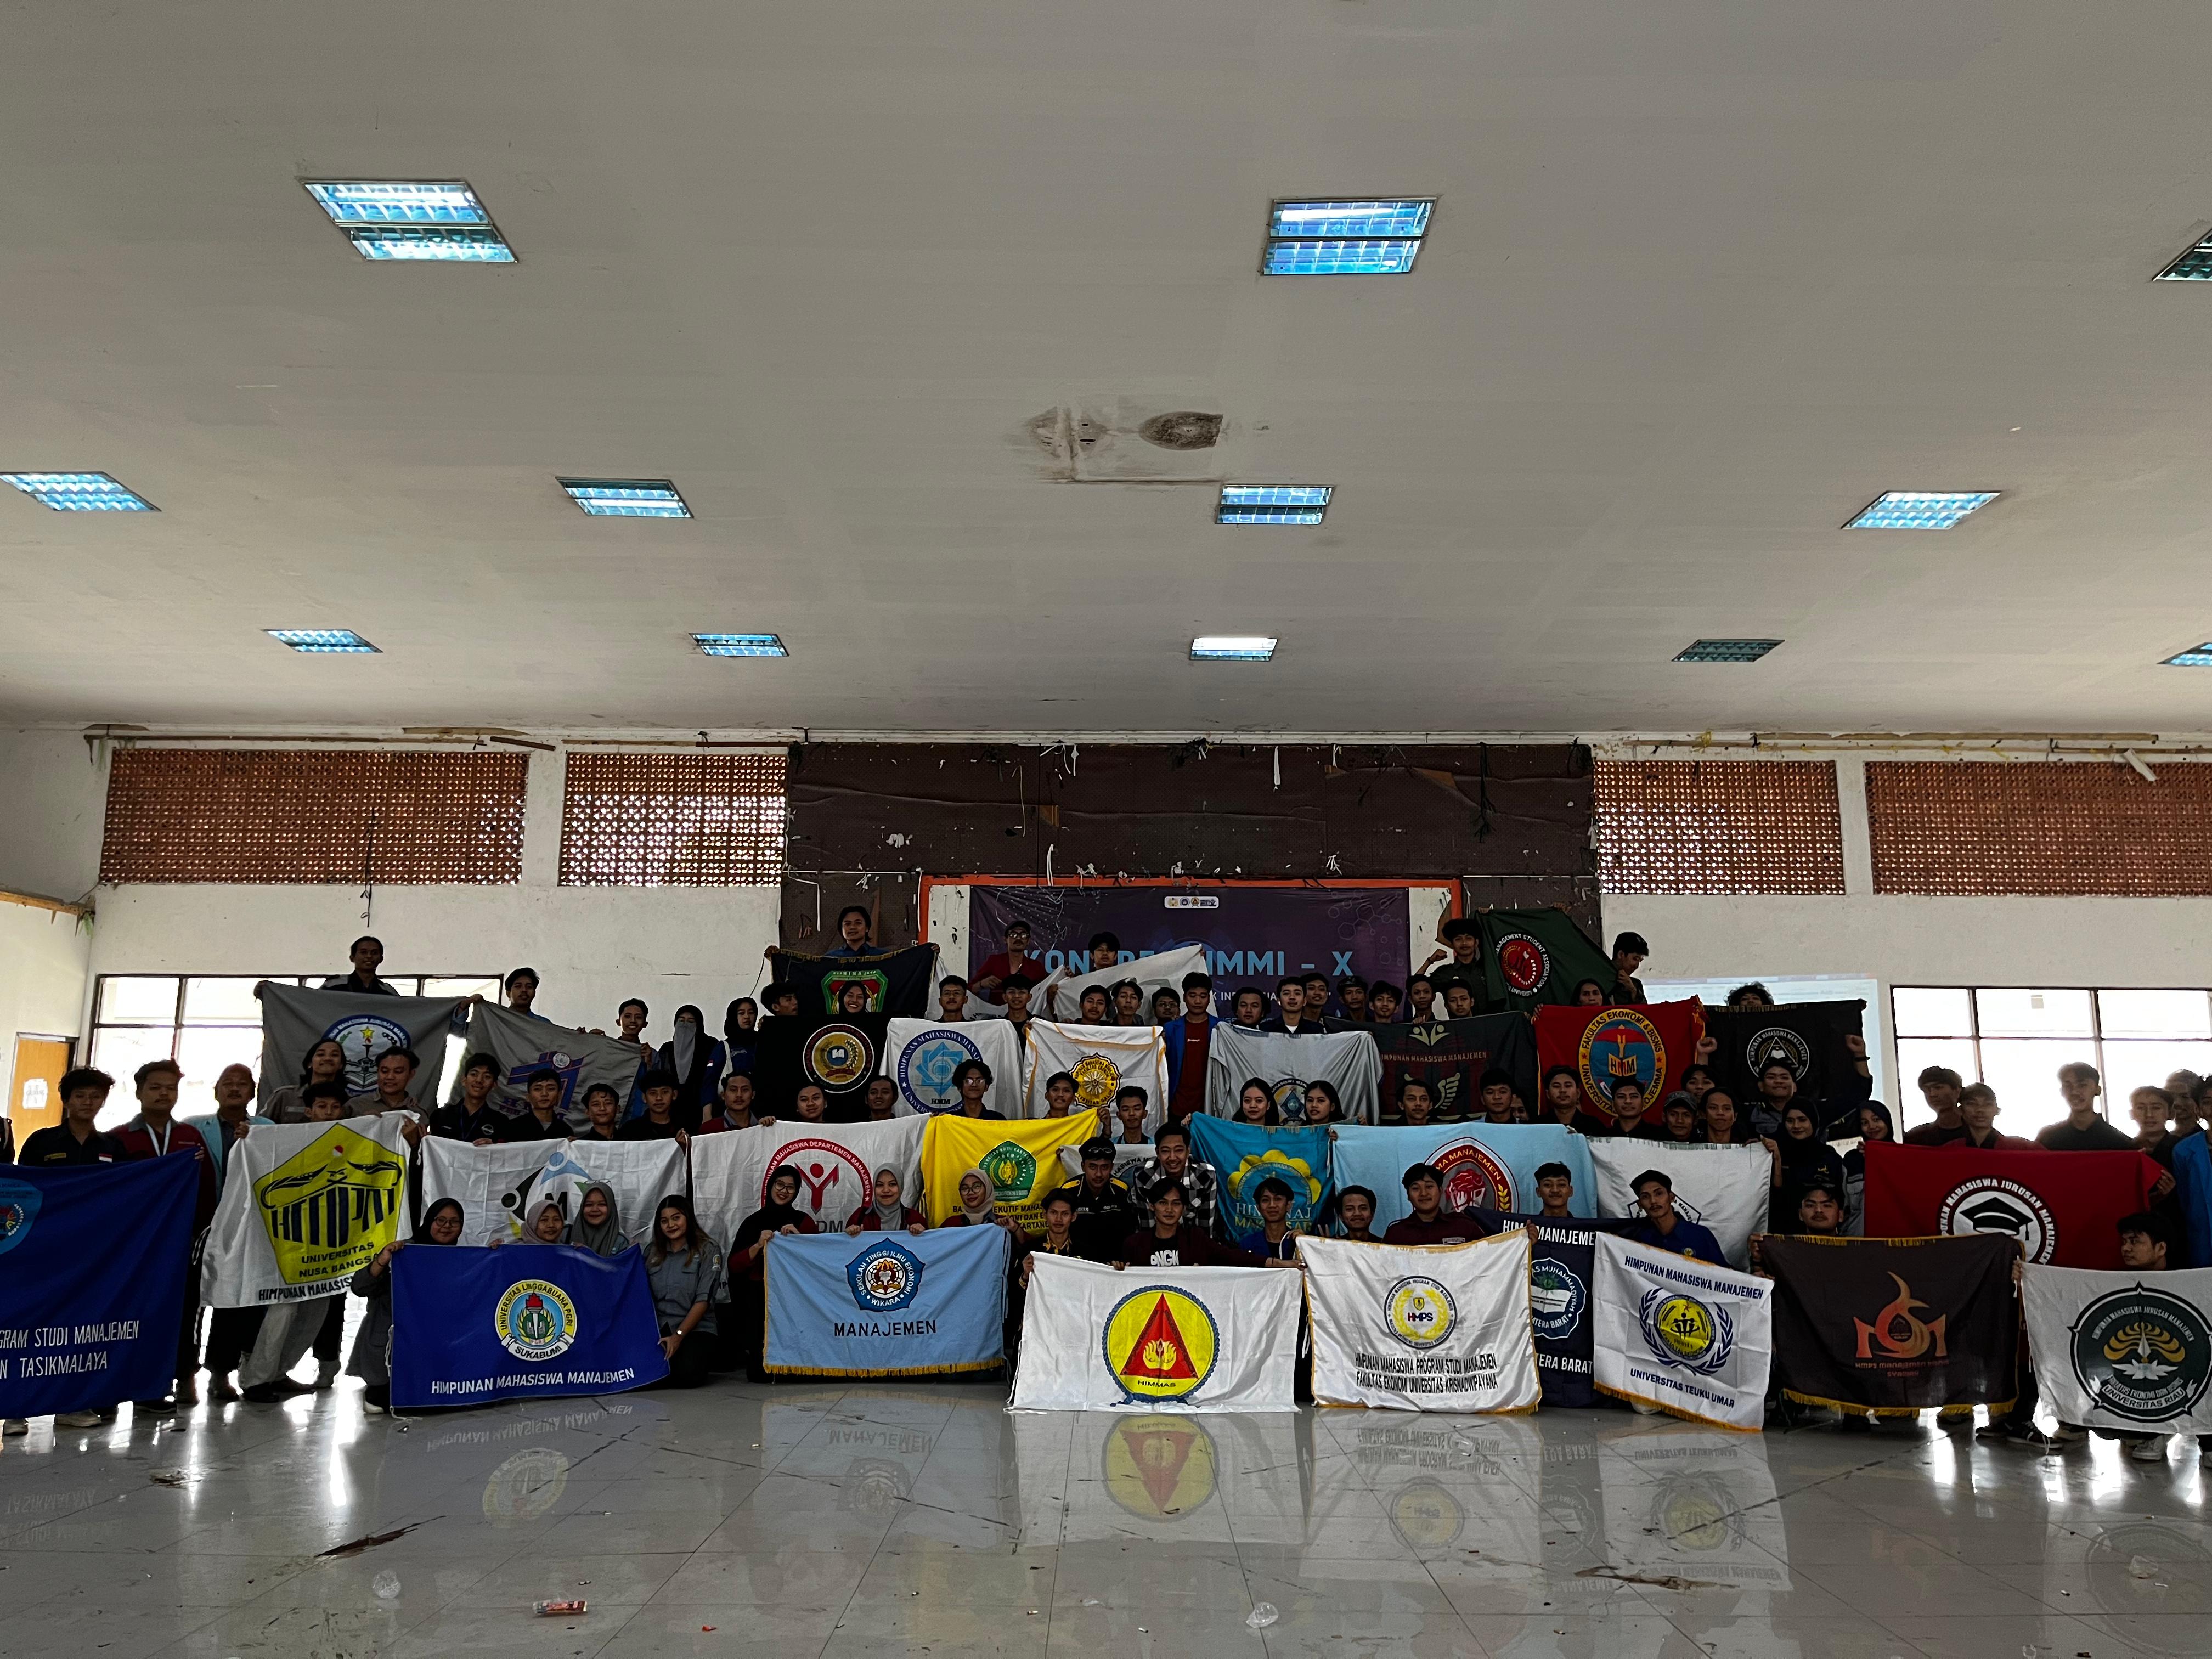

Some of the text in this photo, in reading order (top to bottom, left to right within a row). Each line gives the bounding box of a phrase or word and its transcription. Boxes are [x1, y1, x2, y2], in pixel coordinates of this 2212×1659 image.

[1332, 951, 1353, 975] X
[1582, 1016, 1607, 1049] FAKULTAS
[1607, 1011, 1645, 1025] EKONOMI
[1647, 1029, 1663, 1053] BISNIS
[900, 1042, 918, 1077] HIMPUNAN
[917, 1031, 961, 1042] MAHASISWA
[1381, 1052, 1487, 1063] IMPUNAN MAHASISWA MANAJEMEN
[1582, 1064, 1616, 1113] UNIVERSITA
[775, 1141, 808, 1160] MAHASISWA
[809, 1141, 851, 1160] DEPARTEMEN
[850, 1157, 871, 1194] MANAJEMEN
[1113, 1157, 1142, 1176] HASISWA
[1449, 1149, 1502, 1181] MANAJEMEN
[1945, 1178, 1999, 1206] MAHASISWA
[2001, 1180, 2043, 1209] JURUSAN
[992, 1205, 1019, 1214] EKUTIF
[1020, 1204, 1043, 1213] MAHAS
[1940, 1205, 1951, 1235] PUNAN
[817, 1220, 843, 1233] DM
[1022, 1221, 1049, 1229] ARTANE
[1503, 1219, 1595, 1246] HIM MANAJEME
[301, 1242, 375, 1263] UNIVERSITAS
[299, 1267, 328, 1278] NUSA
[856, 1250, 915, 1295] SEKOLAH TINGGI ILMU EKONOMI
[1624, 1256, 1764, 1300] HIMPUNAN MAHASISWA MANAJEMEN
[259, 1276, 354, 1301] HIMPUNAN MAHASIS
[1542, 1266, 1577, 1312] MUHAMMADIYAH
[500, 1283, 573, 1330] UNIVERSITAS LINGGABUANA PGRI
[871, 1296, 901, 1307] WIKARA
[834, 1319, 936, 1336] MANAJEMEN
[1408, 1312, 1434, 1322] HMPS
[1532, 1314, 1570, 1329] TERA BARAT
[0, 1319, 140, 1349] GRAM STUDI MANAJEMEN
[515, 1344, 562, 1359] SUKABUMI
[1355, 1352, 1497, 1375] HIMPUNAN MAHASISWA PROGRAM STUDI MANAJEMEN
[1539, 1353, 1593, 1374] ERA BARAT
[20, 1351, 108, 1378] TASIKMALAYA
[431, 1367, 635, 1395] HIMPUNAN MAHASISWA MANAJEMEN
[1356, 1370, 1383, 1389] FAKULTAS
[1384, 1376, 1407, 1393] EKONOMI
[1409, 1377, 1444, 1394] UNIVERSITAS
[1630, 1368, 1735, 1408] UNIVERSITAS TEUKU UMAR
[2104, 1386, 2184, 1408] UNIVERSITAS RIAU
